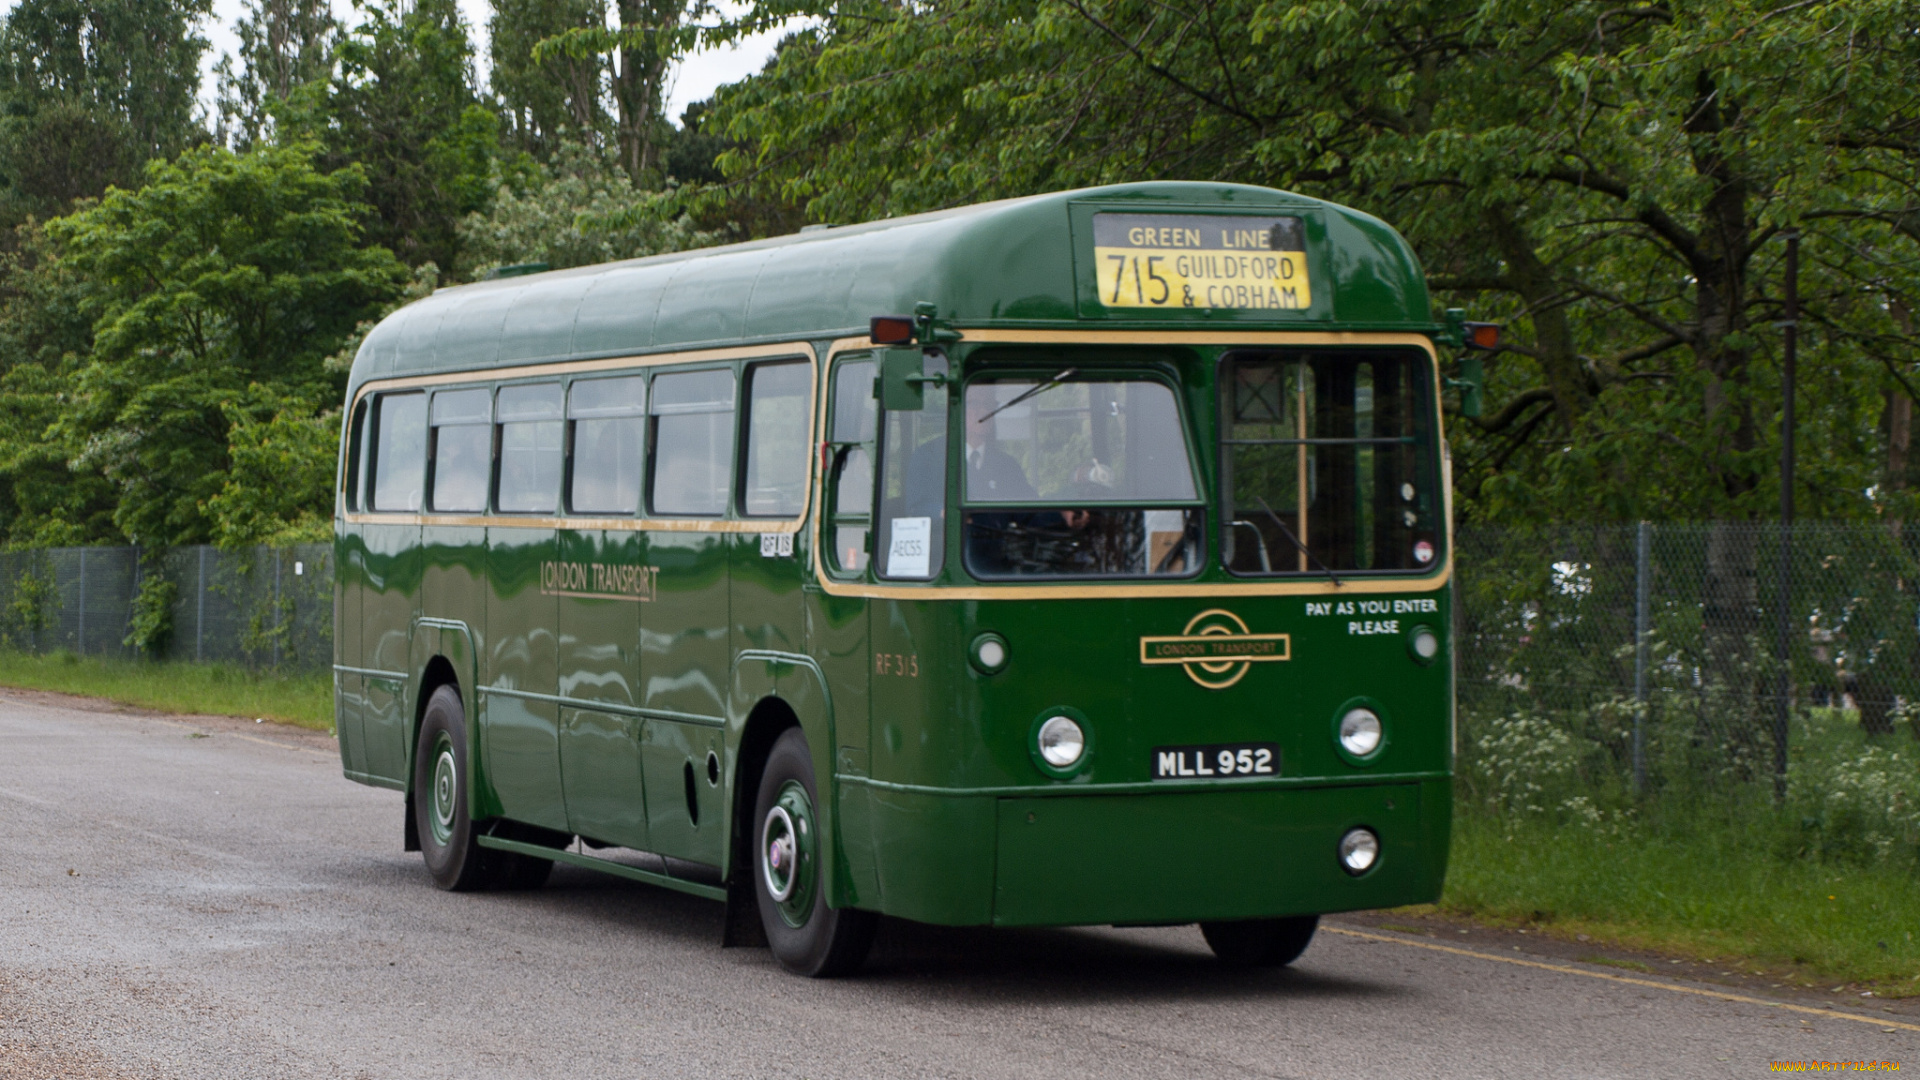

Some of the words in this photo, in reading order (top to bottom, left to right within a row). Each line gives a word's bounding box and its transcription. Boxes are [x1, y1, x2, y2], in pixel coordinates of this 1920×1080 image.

[1128, 227, 1200, 247] GREEN
[1221, 229, 1270, 249] LINE
[1107, 254, 1170, 305] 715
[1176, 255, 1294, 280] GUILDFORD
[1183, 284, 1195, 308] &
[1207, 285, 1298, 309] COBHAM
[540, 561, 588, 595] LONDON
[591, 563, 660, 602] TRANSPORT
[1306, 602, 1332, 616] PAY
[1336, 601, 1355, 615] AS
[1358, 600, 1391, 614] YOU
[1393, 599, 1438, 614] ENTER
[1348, 620, 1400, 635] PLEASE
[1156, 644, 1205, 655] LONDON
[1211, 642, 1276, 654] TRANSPORT
[876, 652, 891, 674] RF
[895, 654, 919, 677] 315
[1158, 751, 1214, 776] MLL
[1217, 748, 1273, 773] 952
